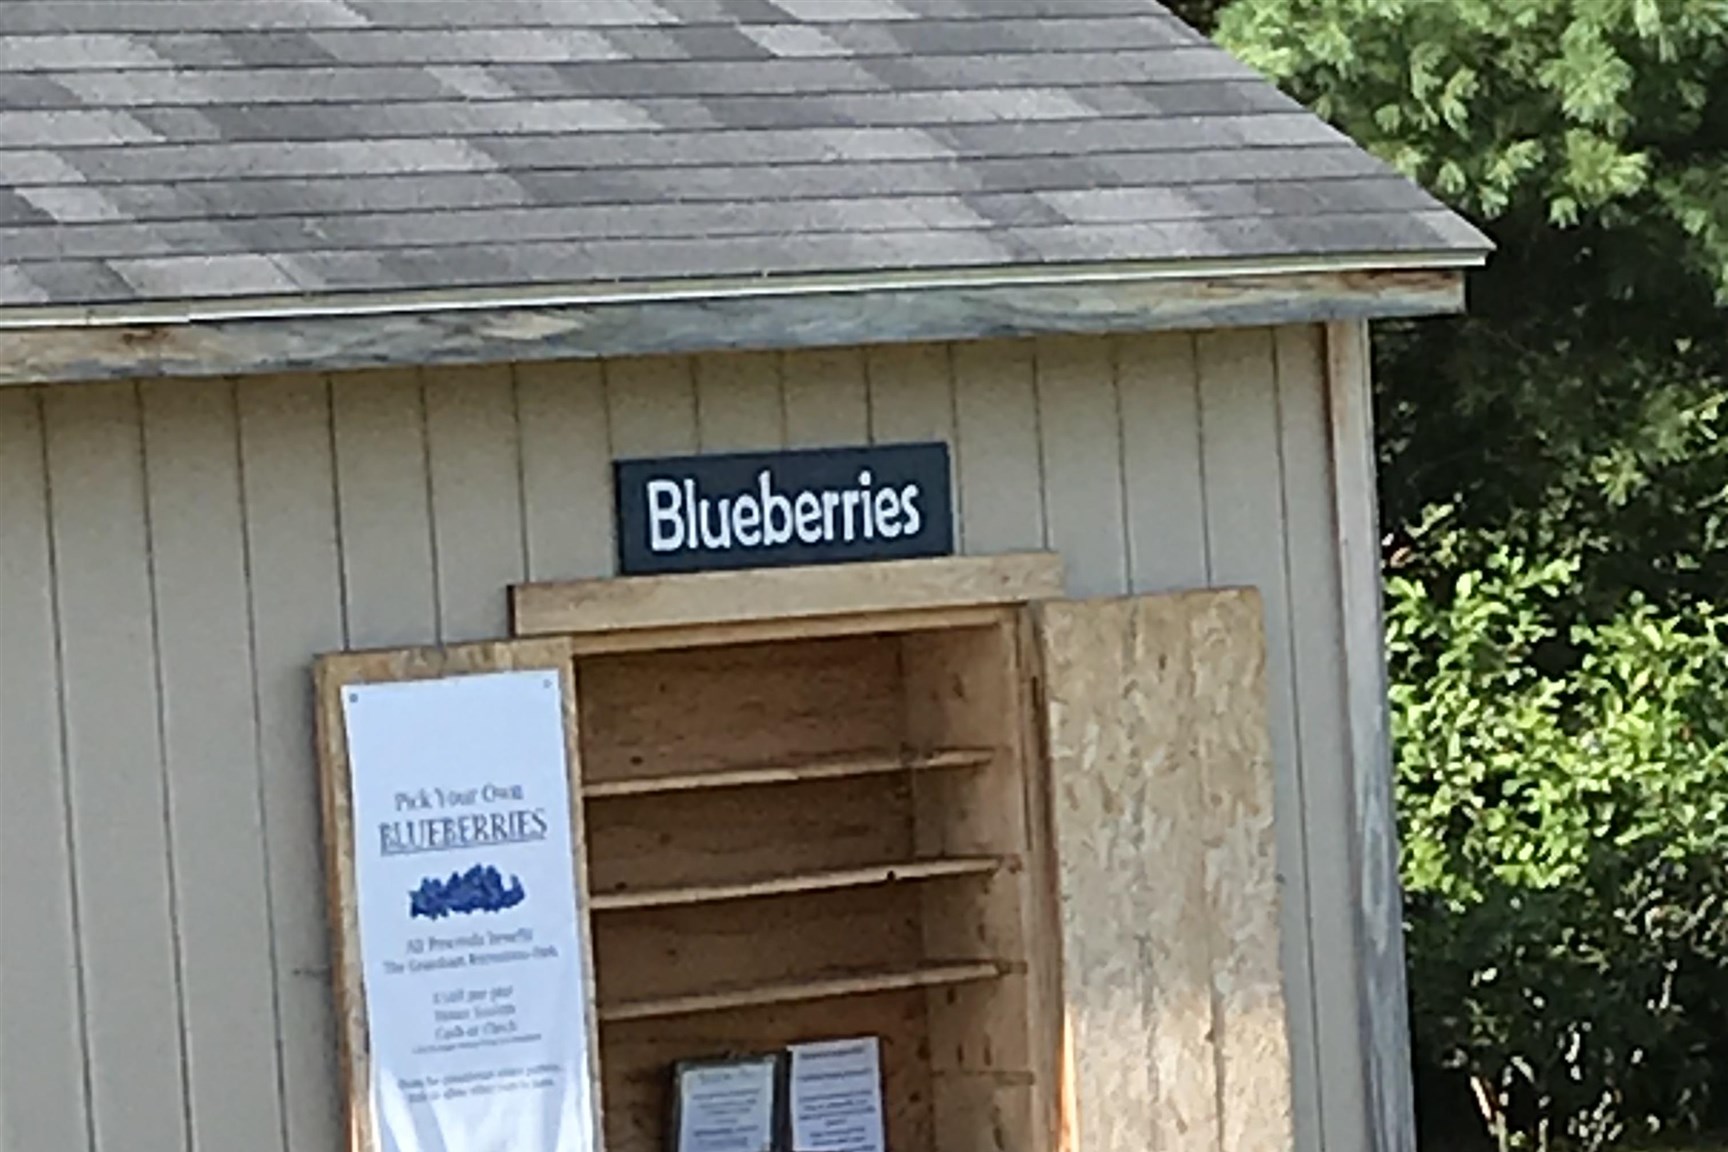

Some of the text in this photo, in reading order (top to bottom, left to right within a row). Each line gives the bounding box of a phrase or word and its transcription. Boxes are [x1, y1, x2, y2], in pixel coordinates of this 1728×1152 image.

[647, 470, 921, 552] Blueberries
[394, 782, 525, 812] Pick Your Own
[378, 808, 548, 855] BLUEBERRIES
